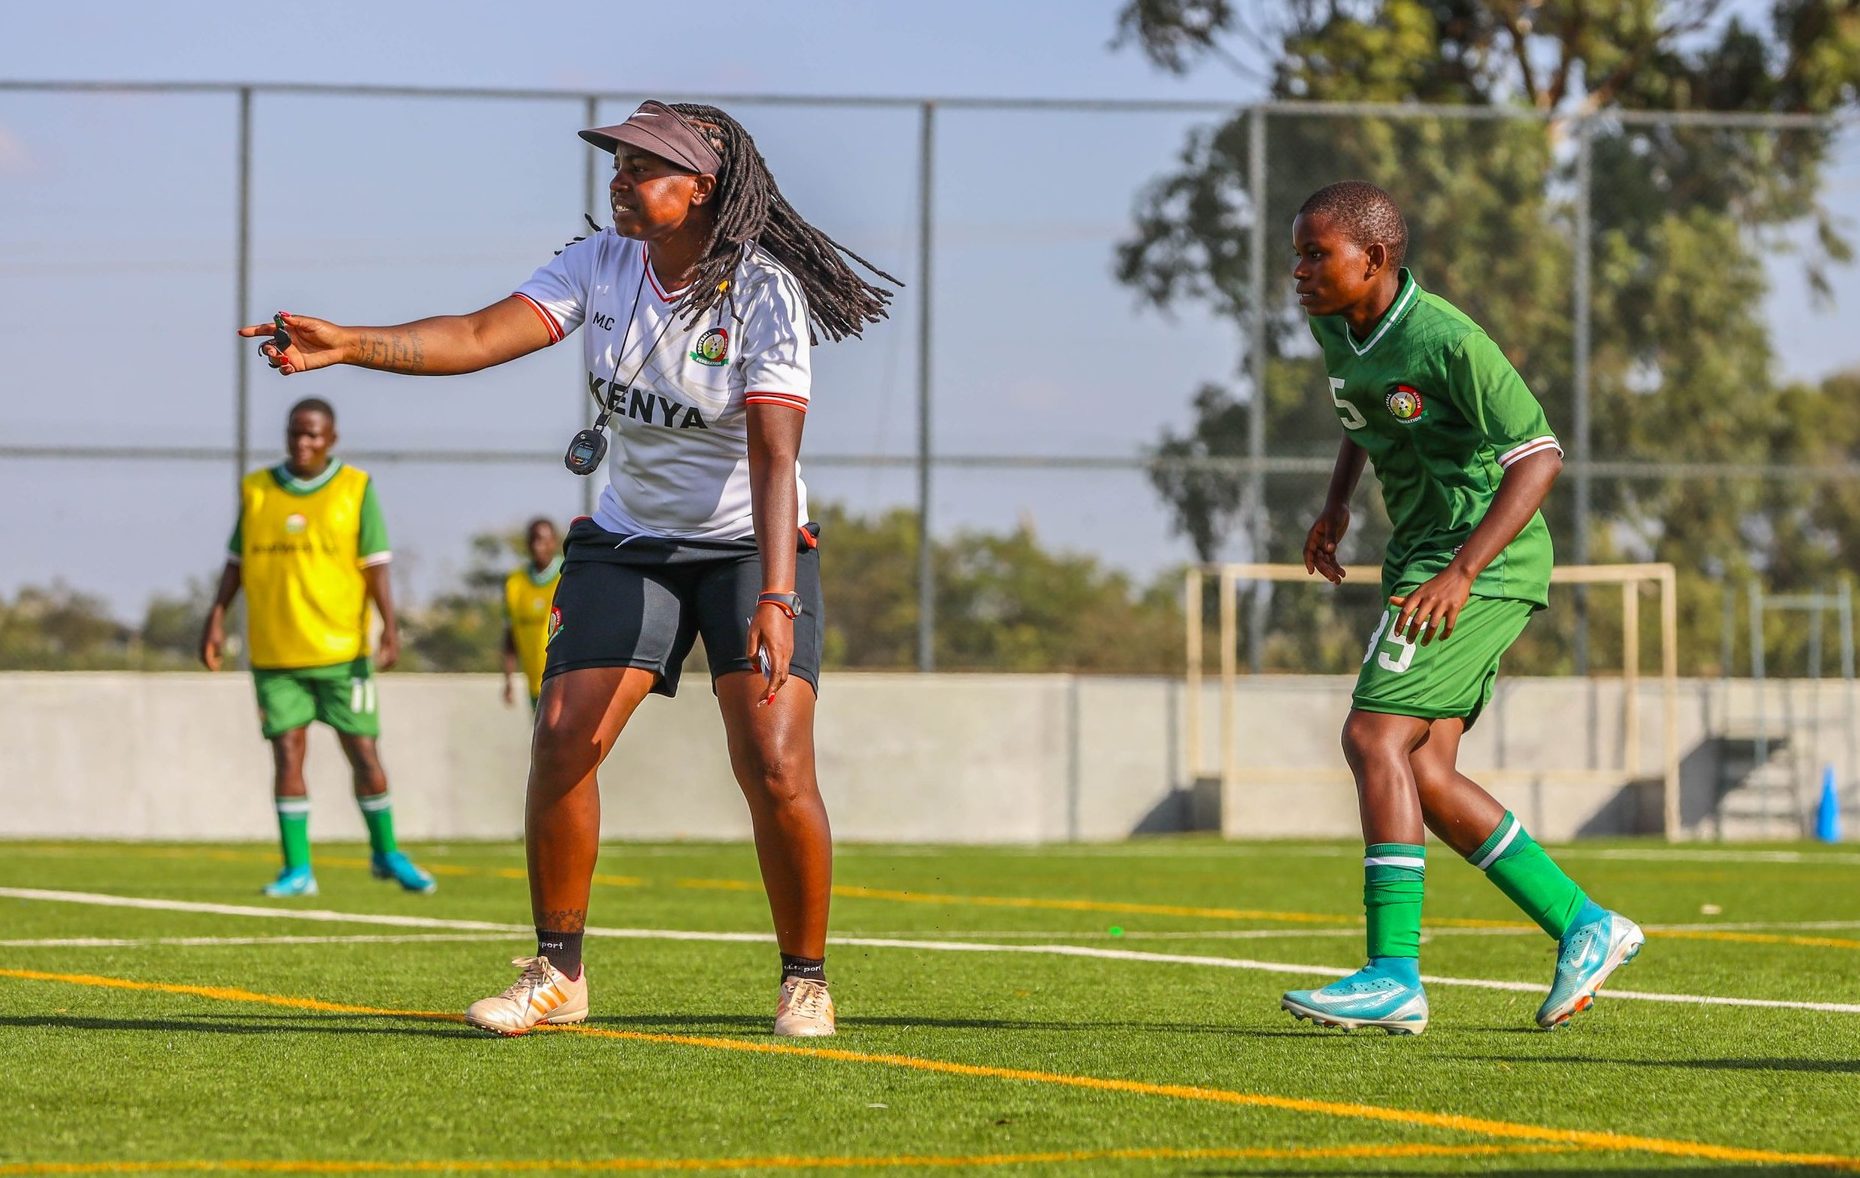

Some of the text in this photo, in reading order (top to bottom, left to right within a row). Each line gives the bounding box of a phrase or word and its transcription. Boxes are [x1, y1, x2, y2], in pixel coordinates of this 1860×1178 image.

[593, 311, 615, 331] M.C
[697, 331, 712, 354] FOOTBALL
[589, 371, 709, 430] KENYA
[350, 677, 375, 713] 11
